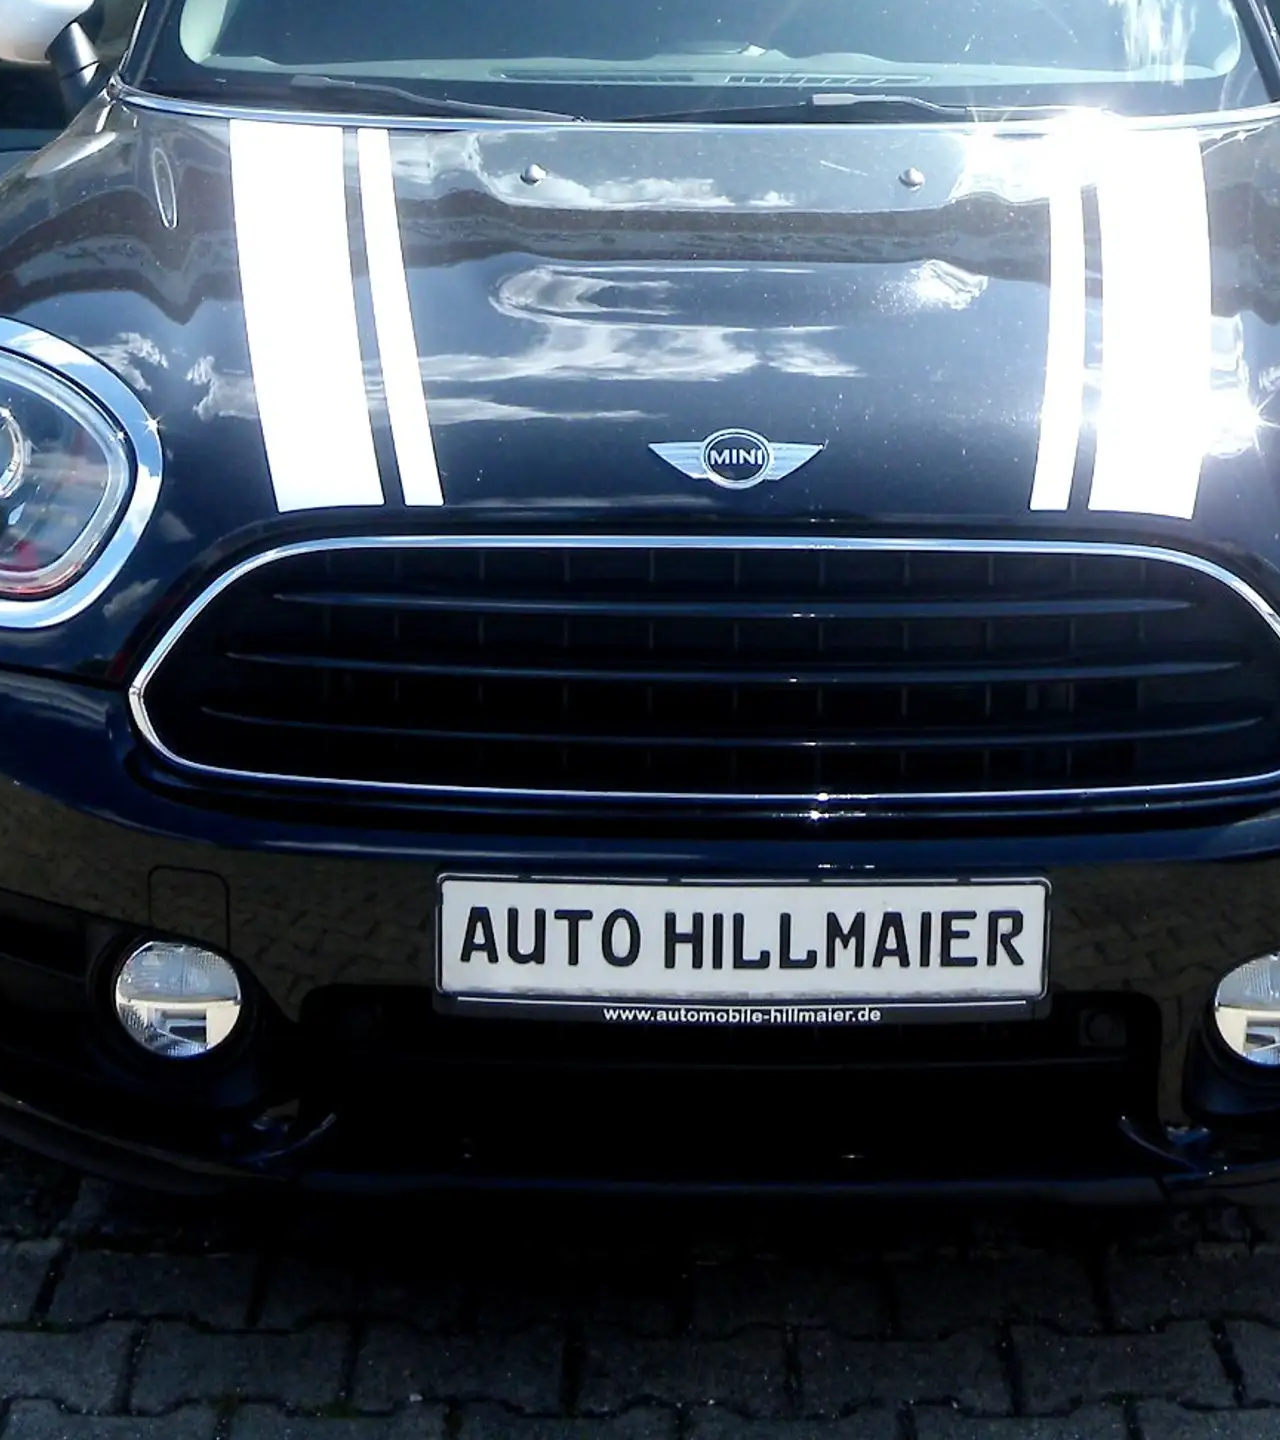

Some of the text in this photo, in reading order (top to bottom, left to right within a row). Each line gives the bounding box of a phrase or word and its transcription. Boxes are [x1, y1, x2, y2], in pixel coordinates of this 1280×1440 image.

[709, 448, 763, 465] MINI
[460, 906, 1025, 970] AUTO HILLMAIER
[602, 1005, 882, 1025] www.automobile-hillmaier.de
